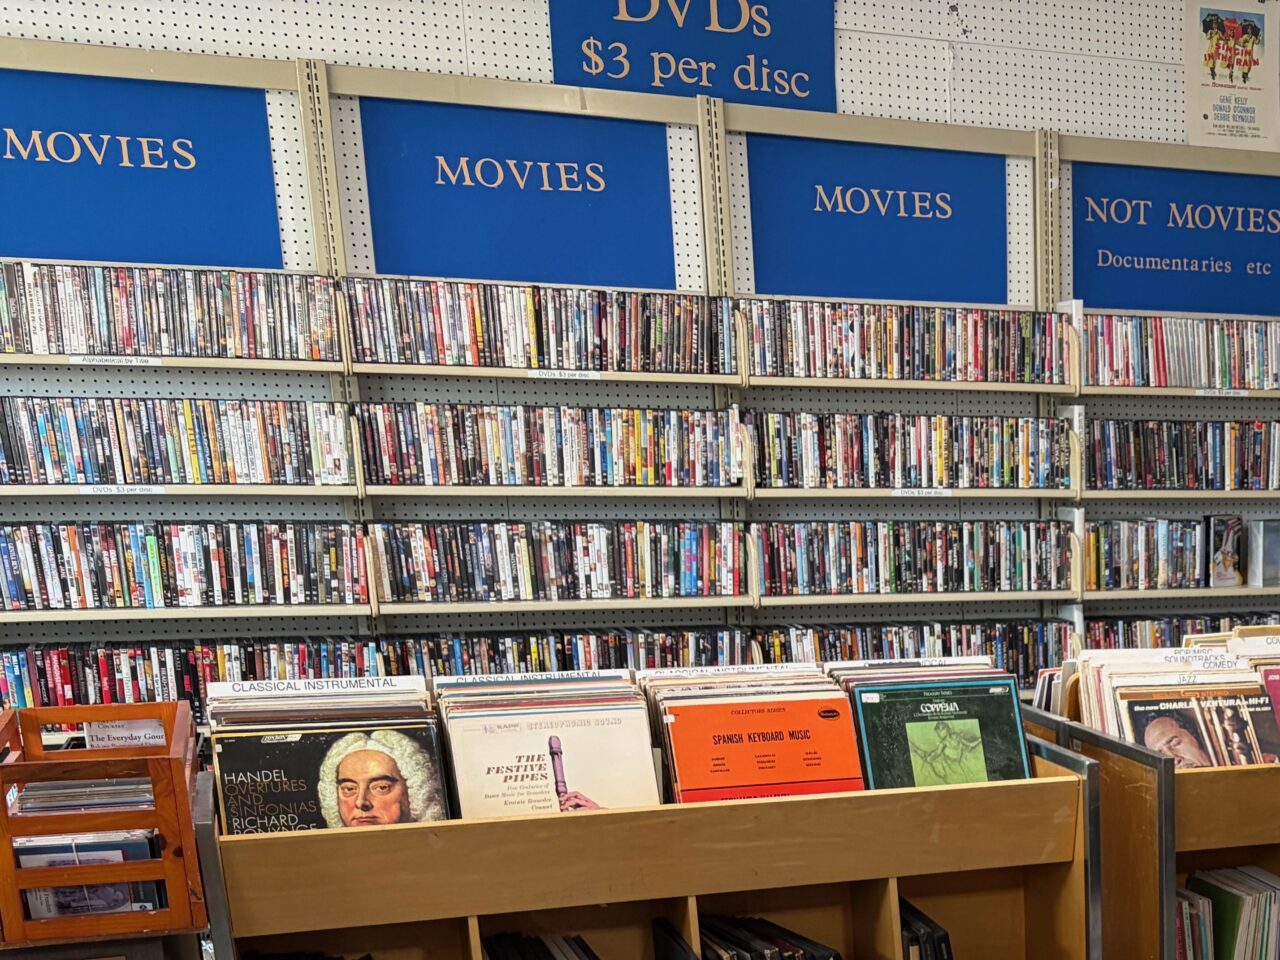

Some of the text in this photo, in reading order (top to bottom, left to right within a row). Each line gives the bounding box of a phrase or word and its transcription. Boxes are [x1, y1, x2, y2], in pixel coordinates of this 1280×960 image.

[613, 0, 771, 37] DVDs
[581, 37, 809, 98] $3 per disc
[1217, 53, 1232, 64] THE
[1236, 58, 1260, 67] RAIN
[3, 127, 196, 169] MOVIES
[435, 156, 606, 193] MOVIES
[814, 185, 952, 219] MOVIES
[1085, 197, 1280, 233] NOT MOVIES
[1097, 250, 1271, 275] Documentaries etc
[1164, 652, 1225, 665] SOUNDTRACKS
[1202, 659, 1237, 670] COMEDY
[232, 678, 397, 693] CLASSICAL INSTRUMENTAL
[1176, 674, 1197, 684] JAZZ
[1159, 700, 1194, 711] CHARLIE
[1200, 697, 1242, 708] VENTURA
[1249, 695, 1269, 705] HI-FI
[89, 733, 105, 742] The
[107, 734, 142, 745] Everyday
[712, 729, 810, 745] SPANISH KEYBOARD MUSIC
[514, 753, 545, 763] THE
[224, 768, 287, 784] HANDEL
[485, 762, 547, 775] FESTIVE
[502, 772, 548, 783] PIPES
[224, 779, 306, 796] OVERTURES
[227, 793, 262, 806] AND
[230, 800, 316, 818] SINFONIAS
[232, 813, 298, 829] RICHARD
